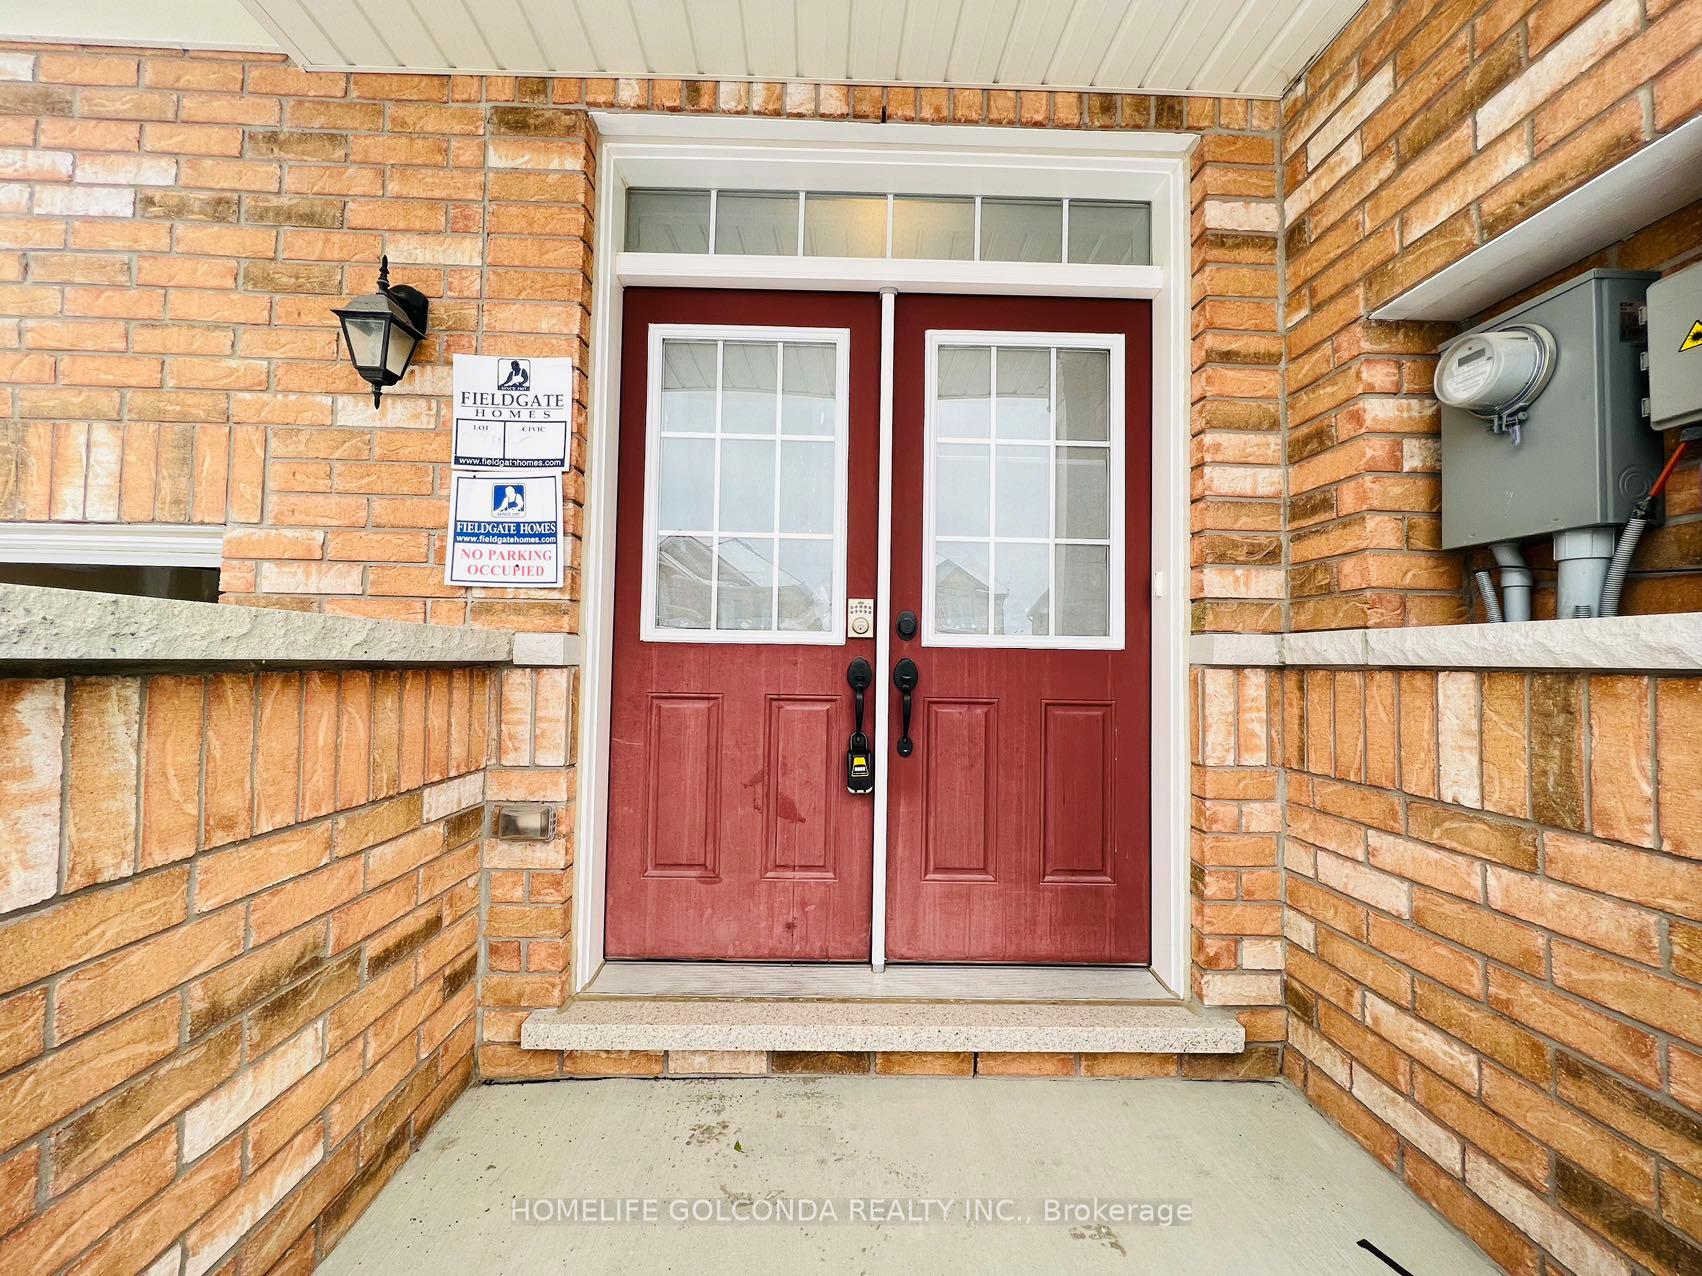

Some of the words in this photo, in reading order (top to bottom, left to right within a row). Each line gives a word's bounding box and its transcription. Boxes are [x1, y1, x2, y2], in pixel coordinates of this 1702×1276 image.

[461, 391, 564, 407] FIELDGATE
[475, 408, 551, 419] HOMES
[456, 522, 517, 534] FIELDGATE
[520, 522, 556, 534] HOMES
[456, 535, 556, 544] www.fieldgatehomes.com
[461, 548, 483, 560] NO
[488, 549, 552, 561] PARKING
[467, 564, 544, 577] OCCUPIED
